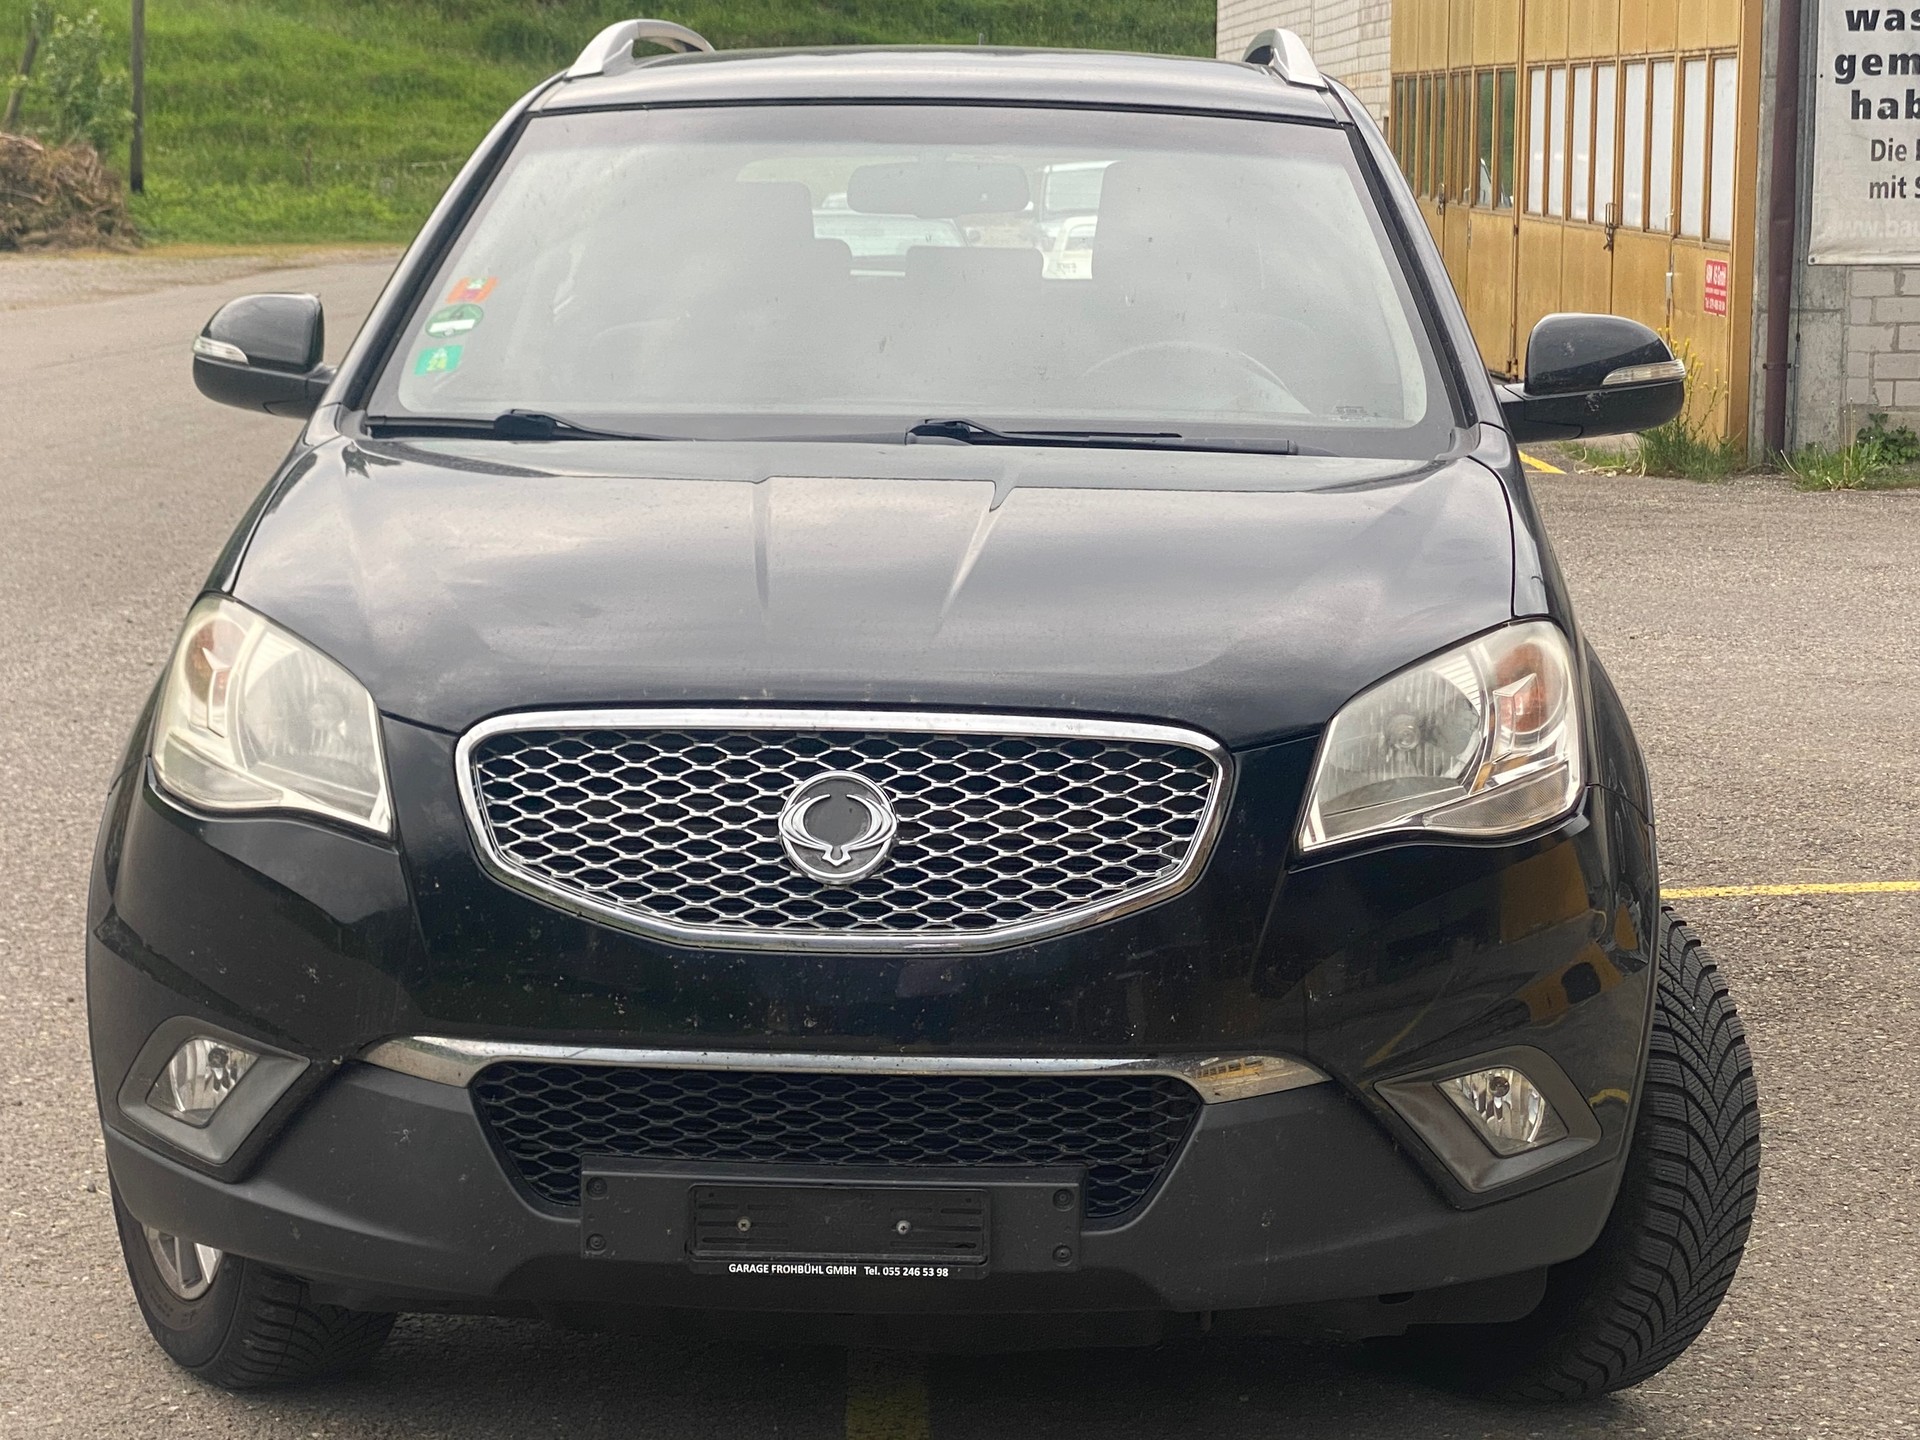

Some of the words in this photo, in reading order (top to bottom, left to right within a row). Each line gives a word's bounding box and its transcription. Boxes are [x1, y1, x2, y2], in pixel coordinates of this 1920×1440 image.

[1845, 9, 1920, 32] was
[1834, 53, 1920, 85] gem
[1851, 89, 1920, 120] hab
[1870, 137, 1908, 162] Die
[1868, 174, 1907, 199] mit
[728, 1263, 770, 1274] GARAGE
[771, 1263, 824, 1275] FROHBÜHL
[825, 1265, 857, 1276] GMBH
[864, 1266, 881, 1276] Tel.
[882, 1266, 901, 1277] 055
[902, 1267, 921, 1277] 246
[922, 1267, 935, 1277] 53
[936, 1267, 949, 1278] 98
